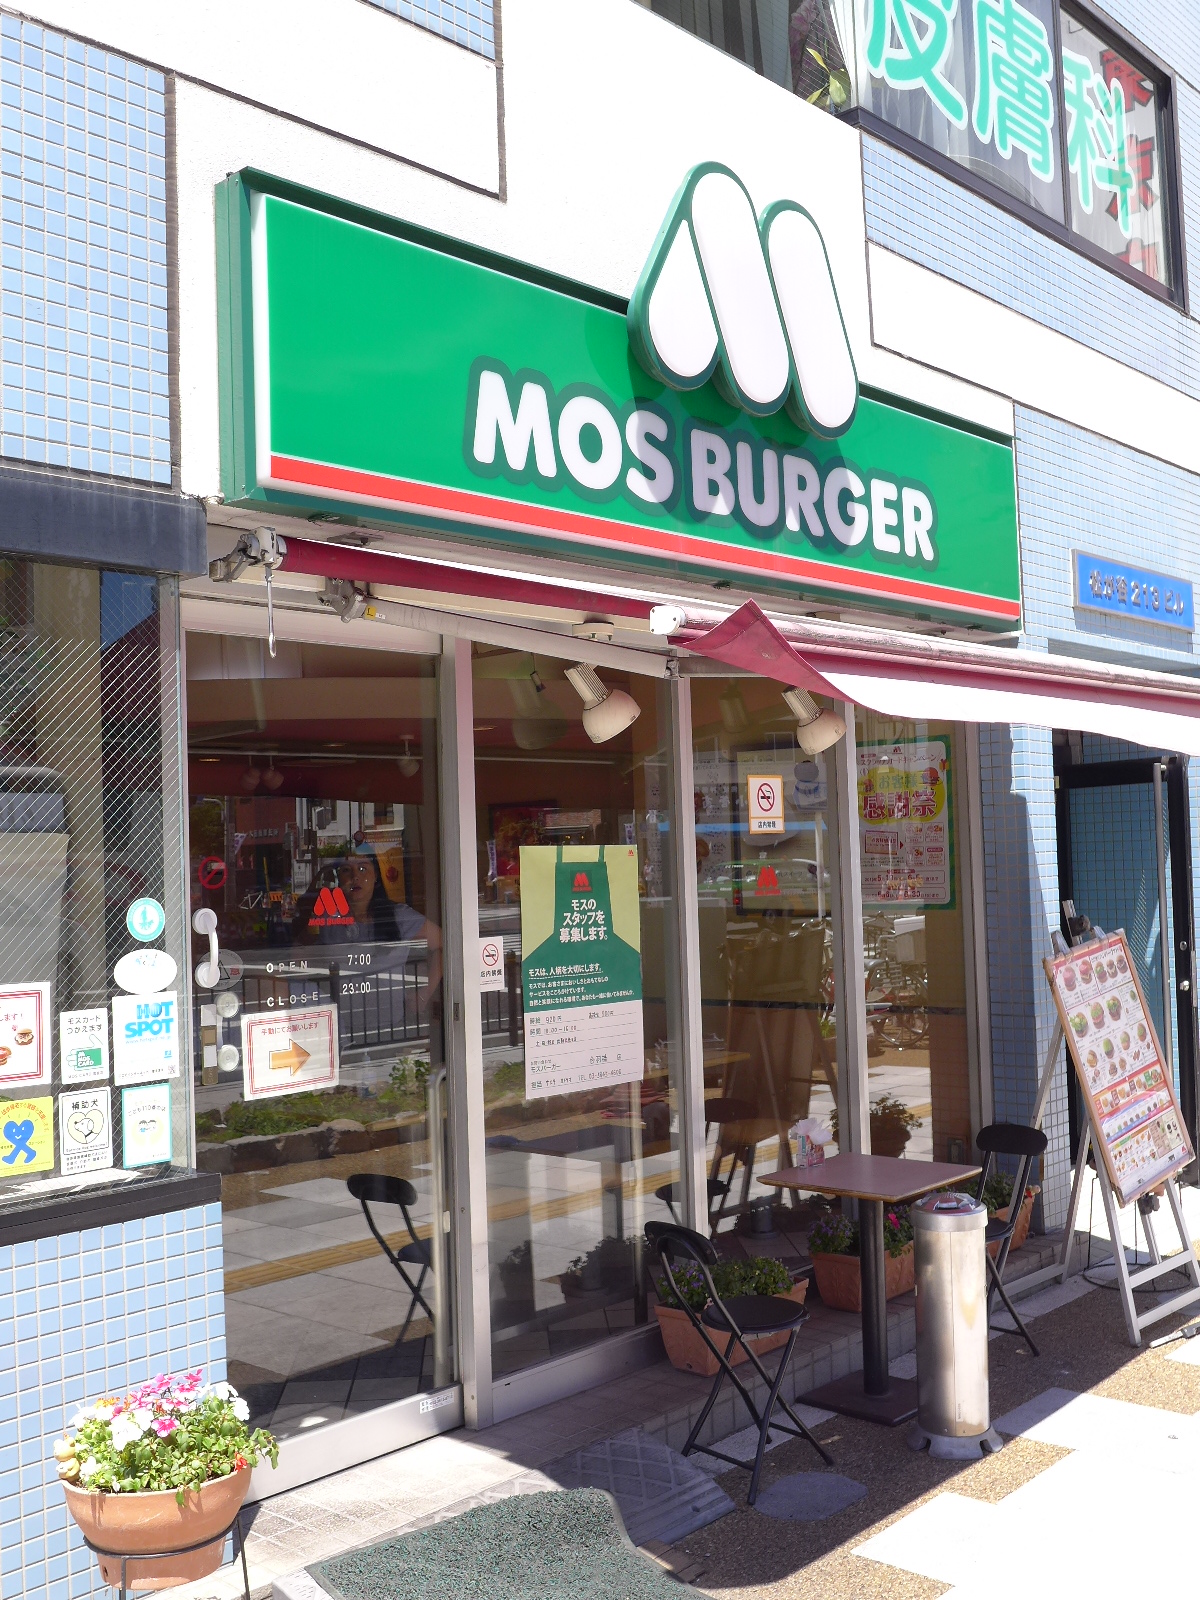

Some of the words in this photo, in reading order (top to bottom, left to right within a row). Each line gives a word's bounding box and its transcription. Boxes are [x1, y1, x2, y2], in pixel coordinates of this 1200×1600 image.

[473, 370, 675, 503] MOS
[690, 428, 935, 562] BURGER
[862, 789, 937, 821] 感謝祭
[571, 899, 597, 911] モスの
[562, 910, 606, 927] スタッフを
[559, 926, 609, 944] 募集します。
[266, 960, 309, 974] OPEN
[347, 953, 372, 966] 7:00
[342, 981, 372, 995] 23:00
[266, 991, 320, 1008] CLOSE
[136, 1000, 174, 1019] HOT
[67, 1014, 101, 1025] モスカード
[66, 1024, 102, 1034] つかえます
[125, 1018, 174, 1038] SPOT
[71, 1098, 99, 1111] 補助犬
